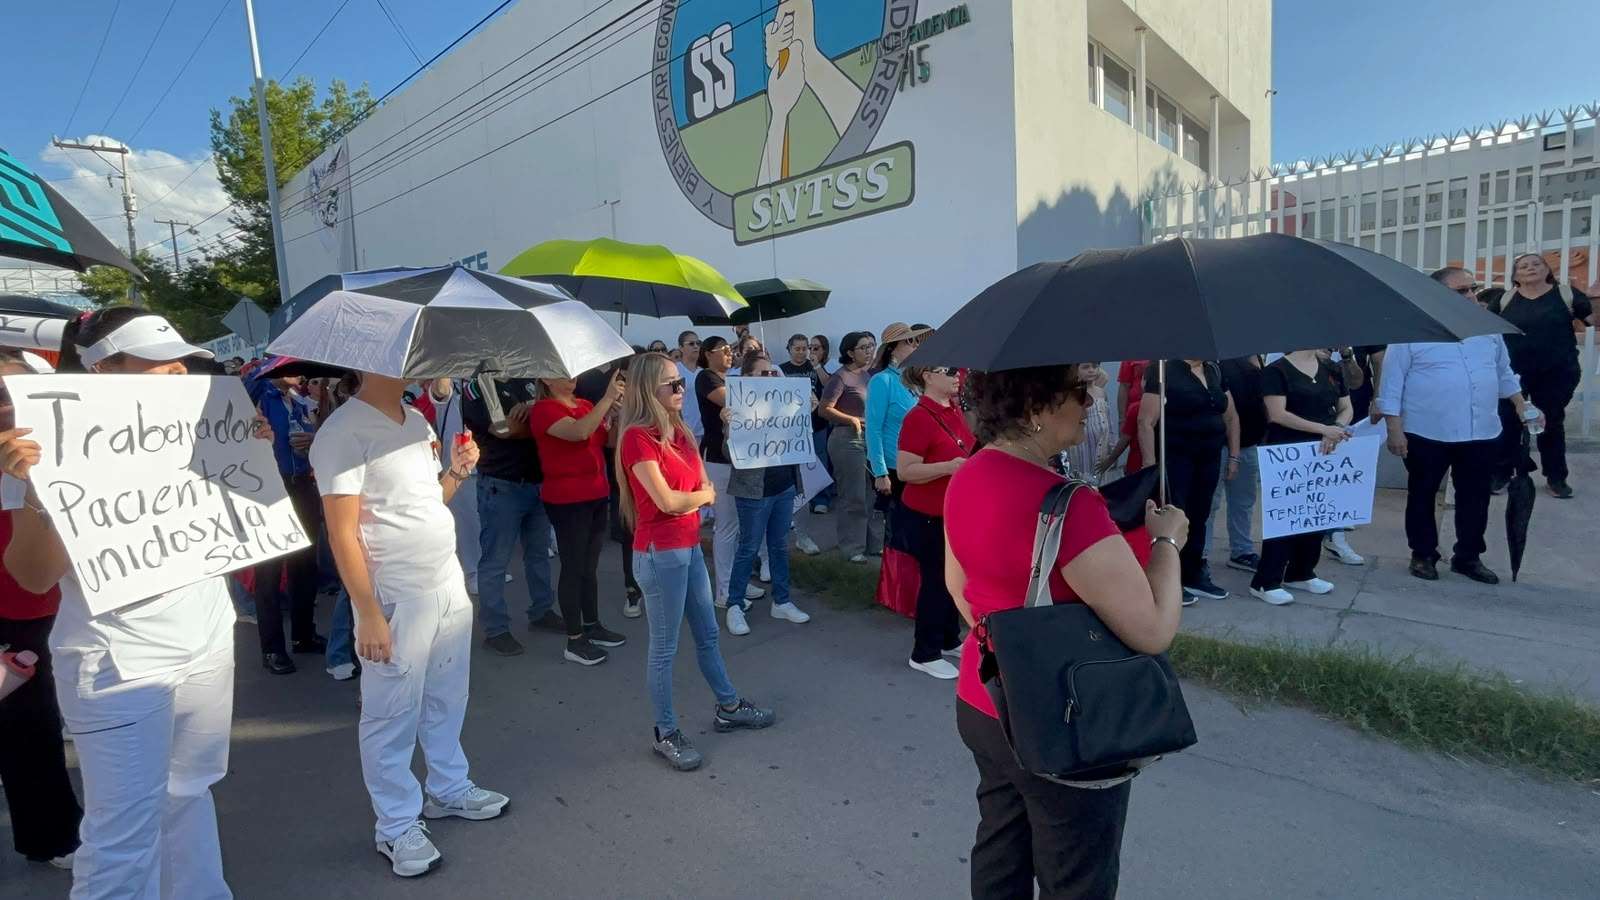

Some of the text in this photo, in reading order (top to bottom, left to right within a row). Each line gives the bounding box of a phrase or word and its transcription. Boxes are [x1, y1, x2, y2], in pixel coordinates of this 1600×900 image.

[684, 21, 735, 121] SS
[860, 0, 909, 129] DORES
[656, 0, 715, 214] Y BIENESTAR ECON
[748, 157, 895, 233] SNTSS
[728, 380, 804, 407] No mas
[27, 391, 262, 469] Trabajador
[1266, 446, 1300, 464] NO
[1340, 456, 1354, 469] A
[49, 459, 263, 538] Pacientes
[1271, 470, 1364, 499] ENFERMAR
[1305, 492, 1326, 504] NO
[1267, 500, 1336, 521] TENEMOS
[1290, 510, 1367, 531] MATERIAL
